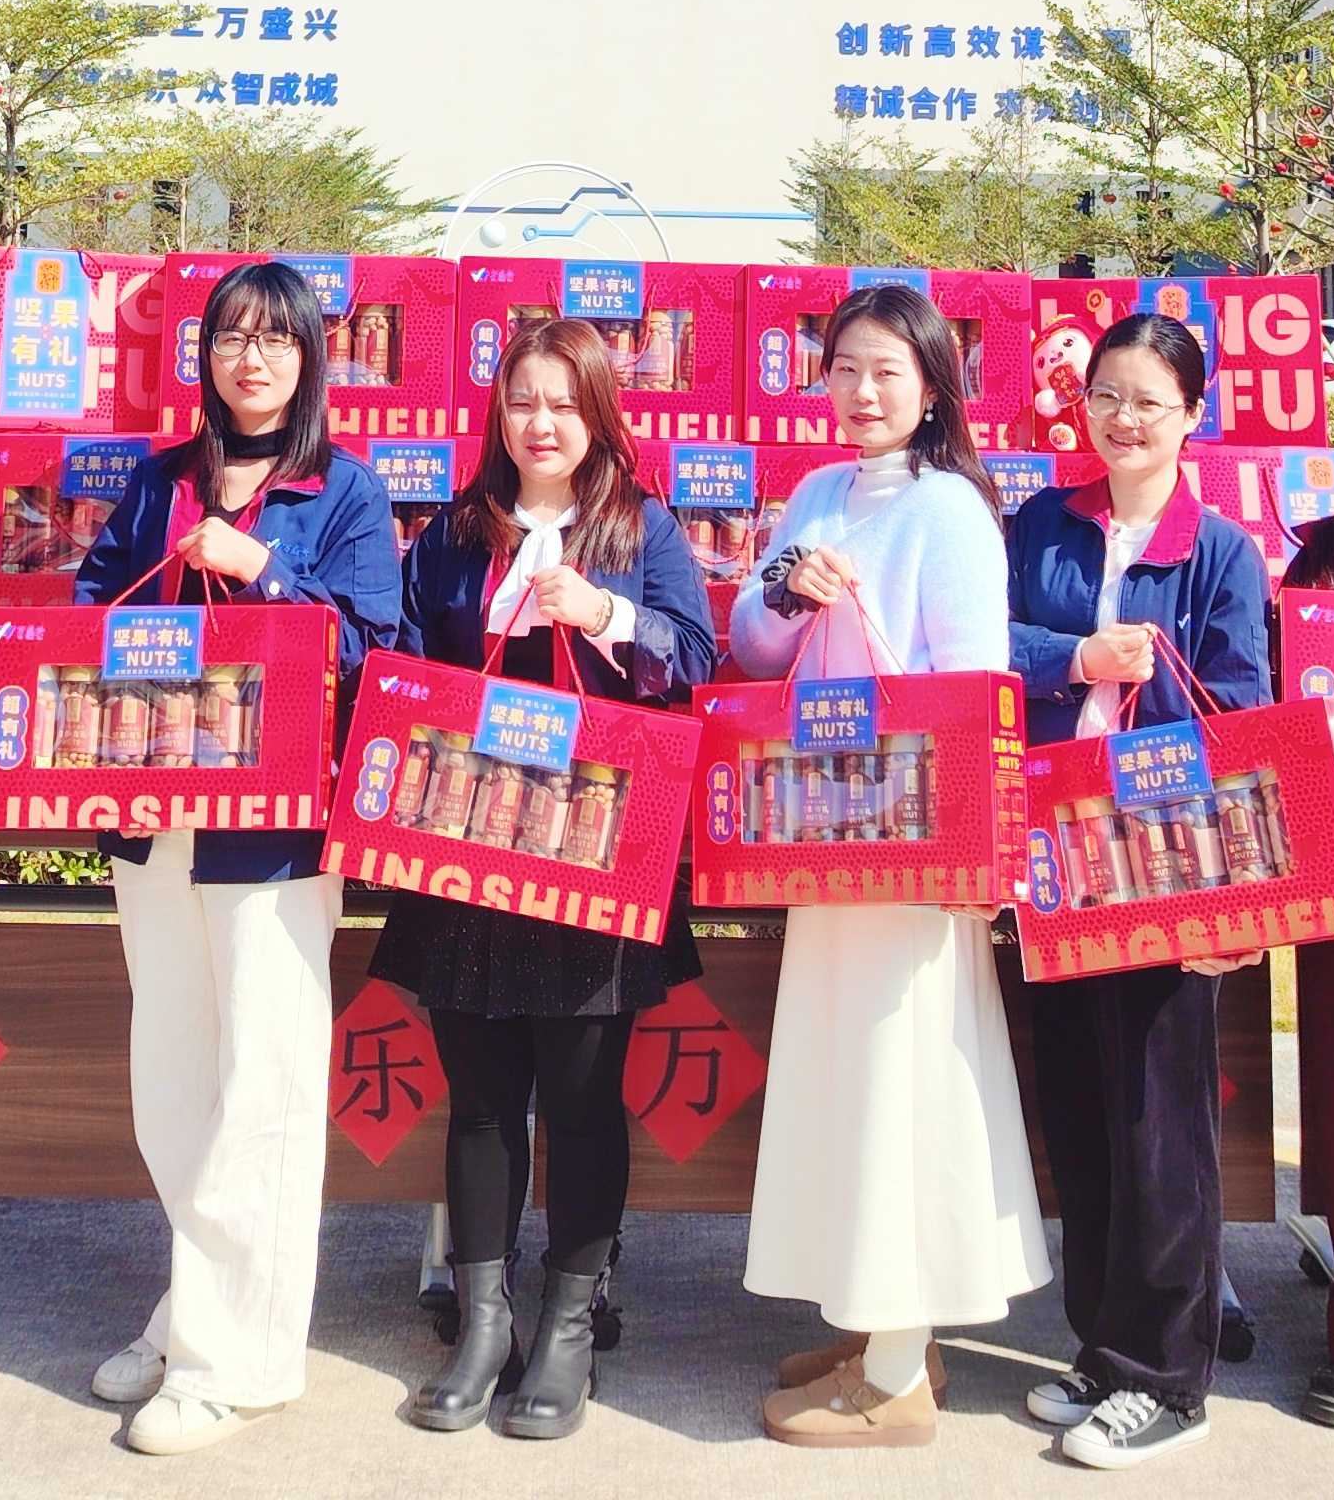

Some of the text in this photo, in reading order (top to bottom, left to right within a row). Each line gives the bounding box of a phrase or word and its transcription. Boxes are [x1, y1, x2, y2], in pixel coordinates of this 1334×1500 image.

[834, 84, 978, 122] 精诚合作
[580, 295, 624, 309] NUTS
[14, 297, 80, 329] 坚果
[11, 335, 78, 367] 有礼
[17, 373, 67, 388] NUTS
[82, 473, 127, 488] NUTS
[388, 477, 433, 491] NUTS
[690, 482, 734, 497] NUTS
[126, 650, 178, 667] NUTS
[812, 720, 856, 739] NUTS
[498, 729, 550, 754] NUTS
[1135, 767, 1186, 791] NUTS
[333, 1019, 428, 1124] 乐
[634, 1018, 726, 1118] 万
